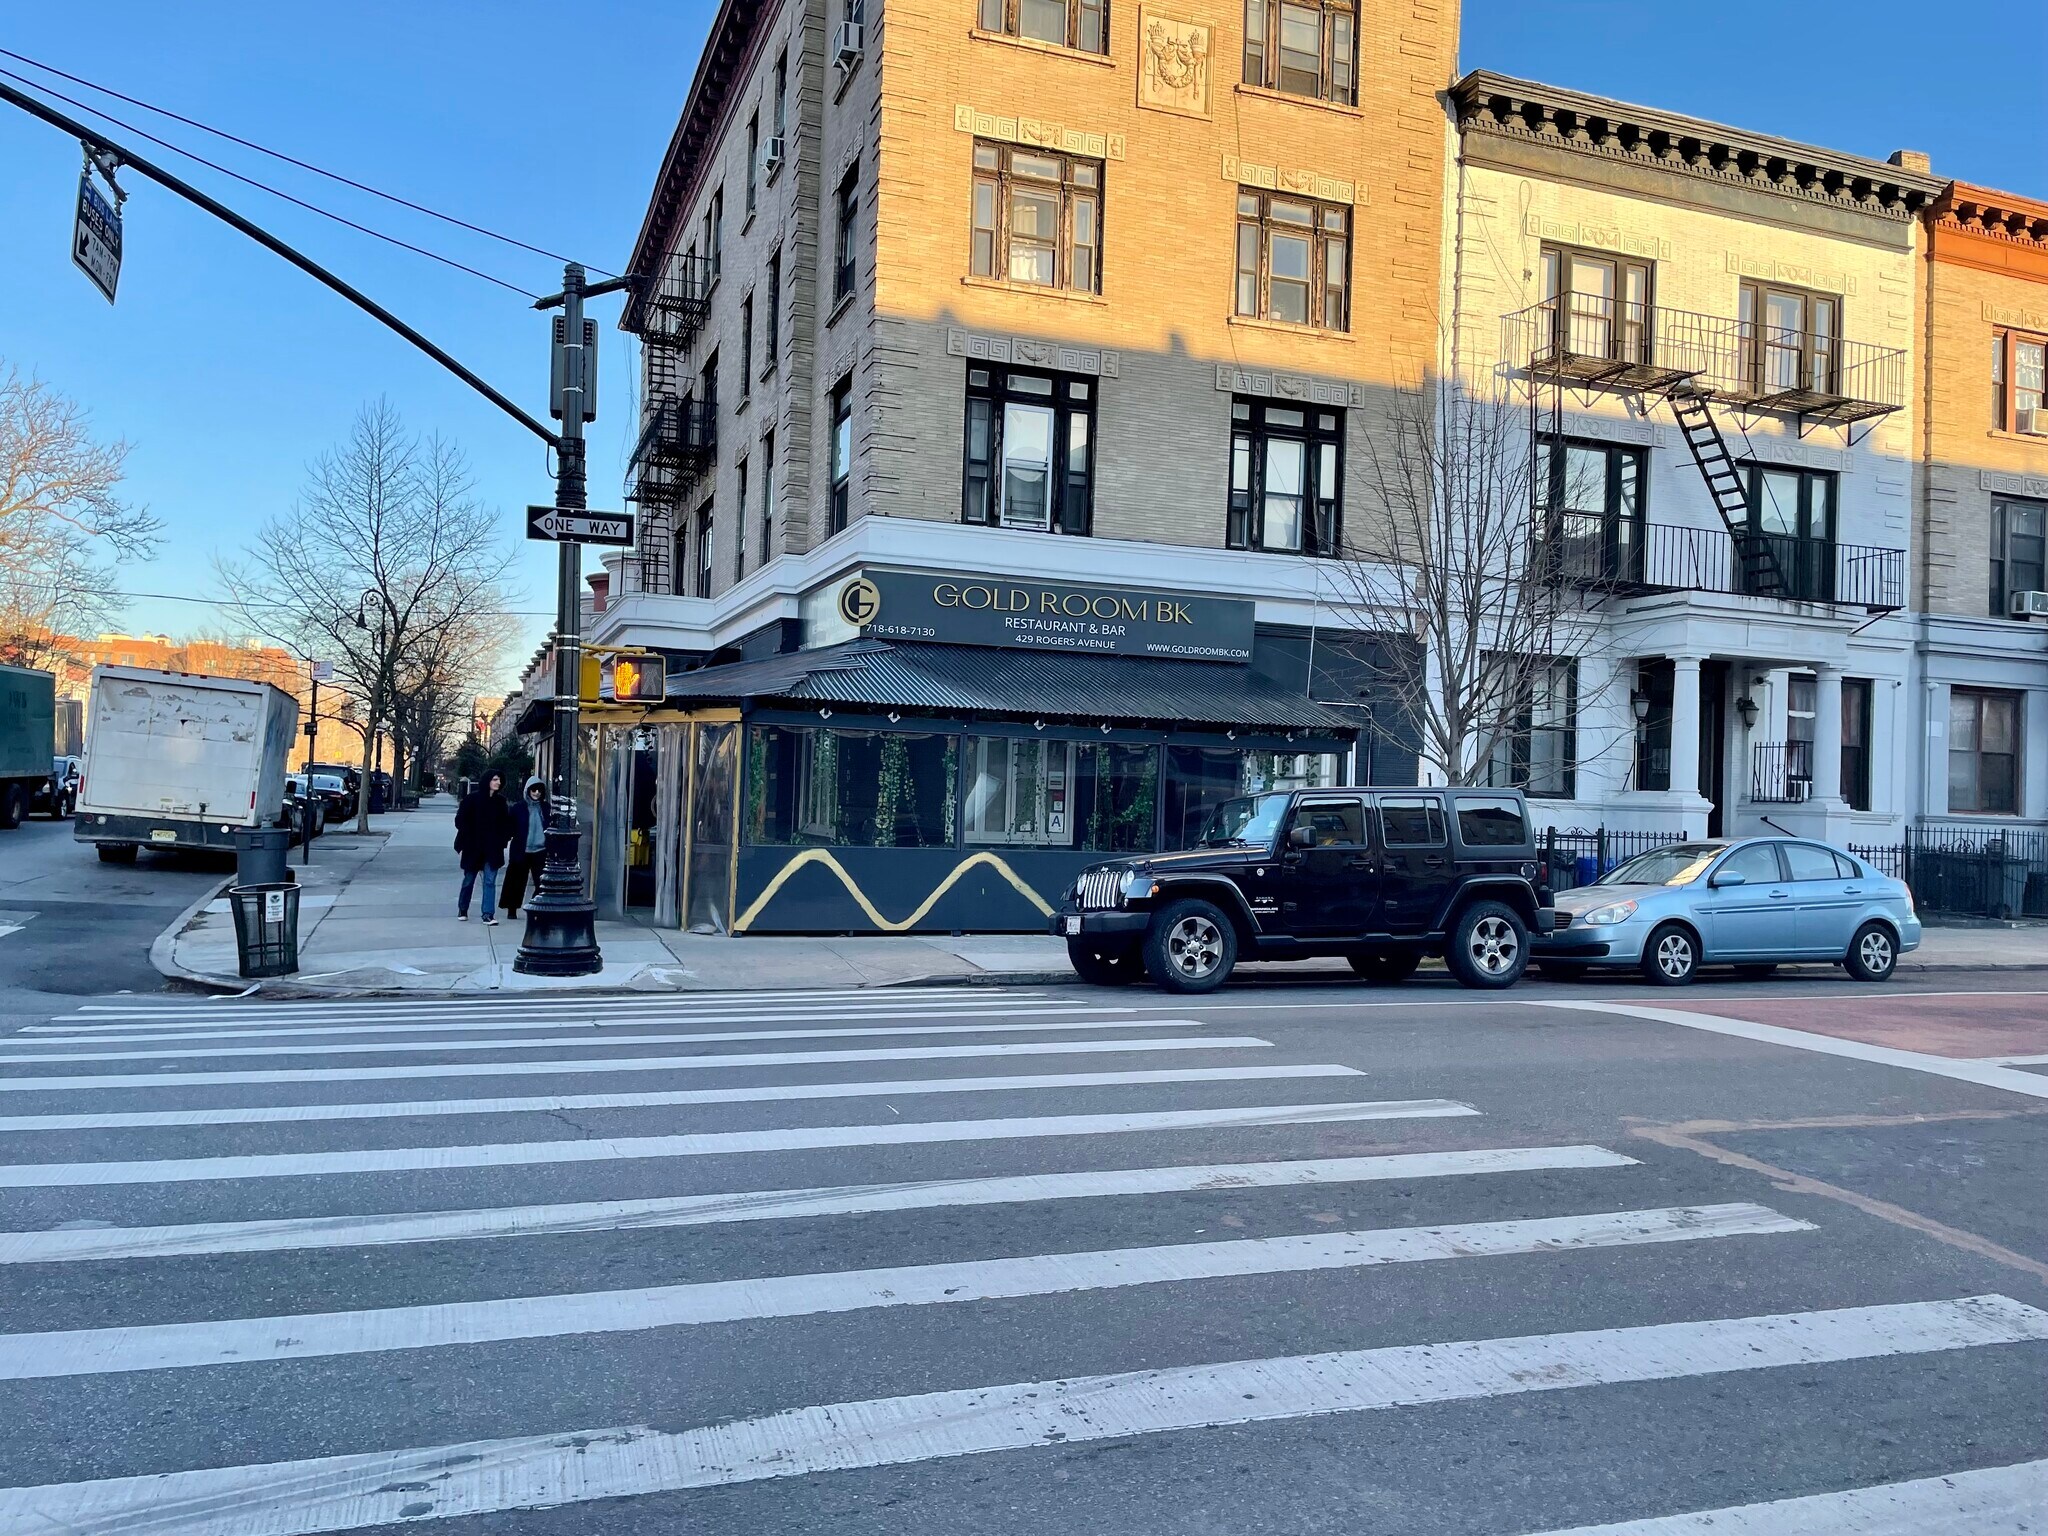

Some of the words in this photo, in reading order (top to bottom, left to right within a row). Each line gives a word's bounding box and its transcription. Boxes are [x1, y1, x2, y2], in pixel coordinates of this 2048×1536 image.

[94, 195, 105, 216] BUS
[105, 209, 120, 234] LANE
[82, 199, 104, 231] BUSES
[105, 225, 120, 249] ONLY
[544, 517, 574, 532] ONE
[589, 521, 620, 535] WAY
[933, 584, 1031, 611] GOLD
[1041, 591, 1147, 621] ROOM
[1157, 601, 1193, 624] BK
[866, 623, 935, 636] 718-618-7130
[1005, 617, 1086, 634] RESTAURANT
[1089, 624, 1098, 635] &
[1102, 625, 1126, 636] BAR
[1015, 635, 1034, 643] 429
[1036, 636, 1076, 647] ROGERS
[1078, 639, 1116, 649] AVENUE
[1147, 643, 1249, 658] WWW.GOLDROOMBK.COM
[1051, 815, 1061, 827] A
